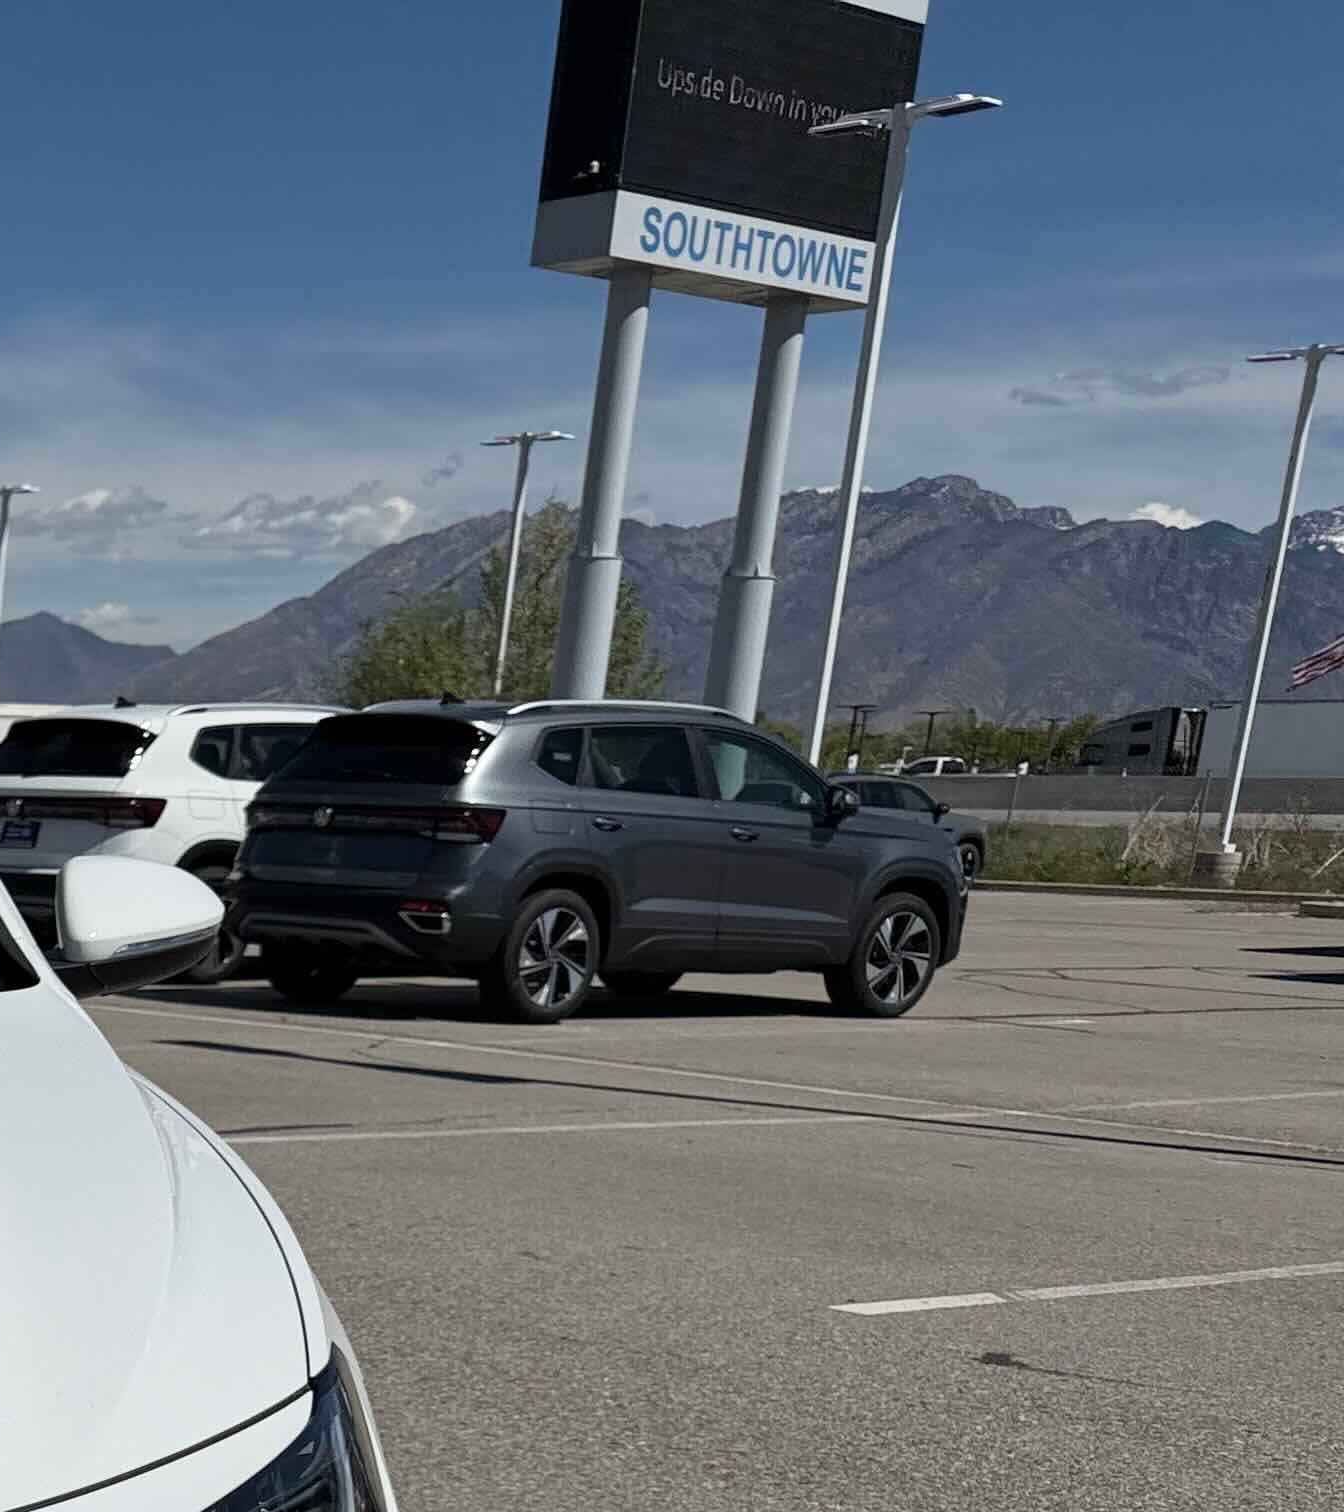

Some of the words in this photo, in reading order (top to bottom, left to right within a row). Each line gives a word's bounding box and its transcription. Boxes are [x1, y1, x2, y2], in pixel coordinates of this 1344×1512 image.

[729, 74, 785, 116] Down
[787, 89, 807, 120] in
[641, 206, 867, 291] SOUTHTOWNE
